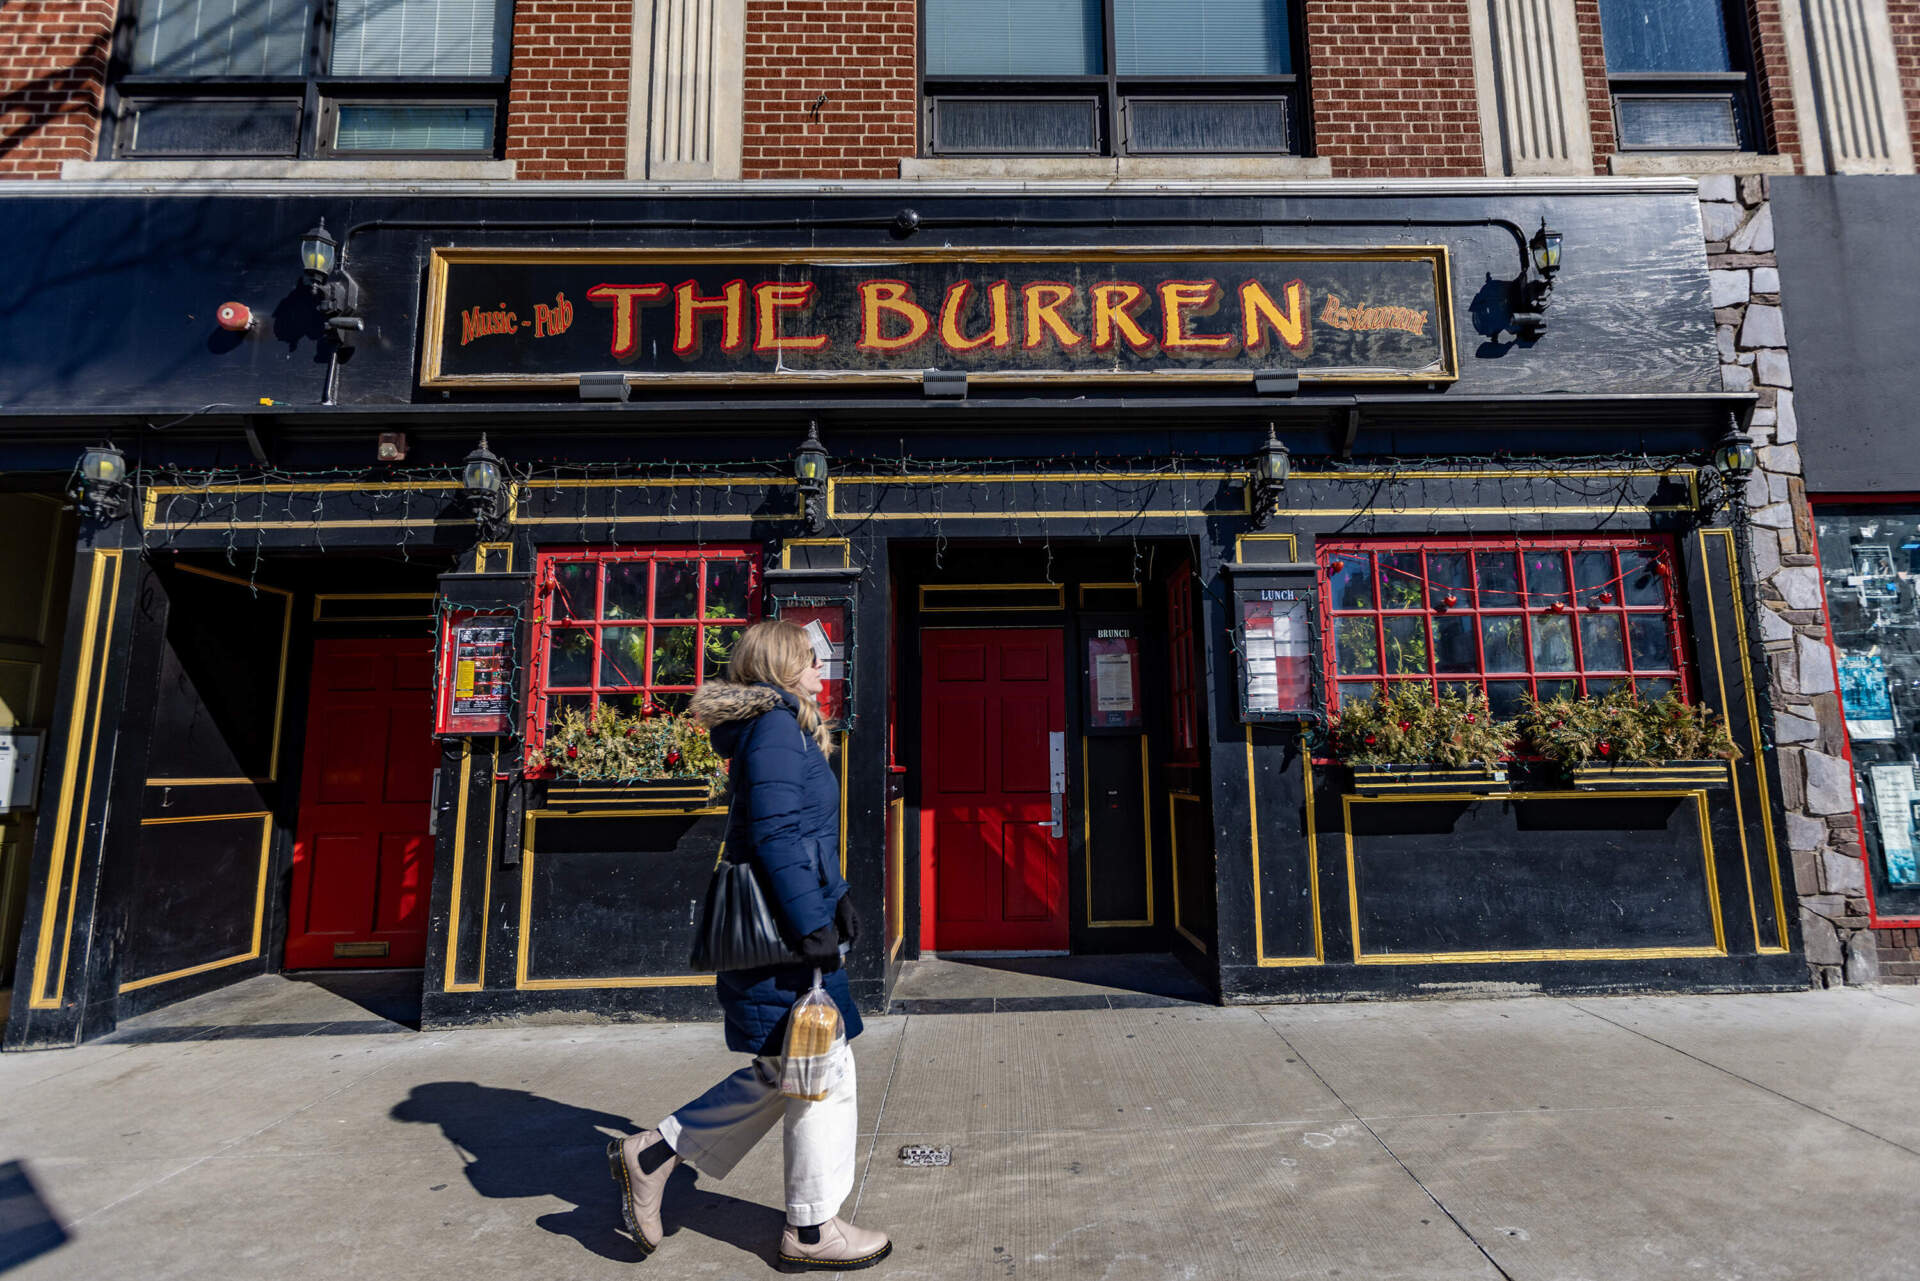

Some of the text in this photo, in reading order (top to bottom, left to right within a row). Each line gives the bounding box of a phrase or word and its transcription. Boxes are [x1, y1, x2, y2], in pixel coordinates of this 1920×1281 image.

[461, 302, 518, 346] Music
[533, 291, 574, 338] Pub
[586, 278, 1306, 360] THE BURREN
[1320, 293, 1428, 336] Restaurant
[1261, 590, 1295, 601] LUNCH
[1097, 629, 1130, 638] BRUNCH
